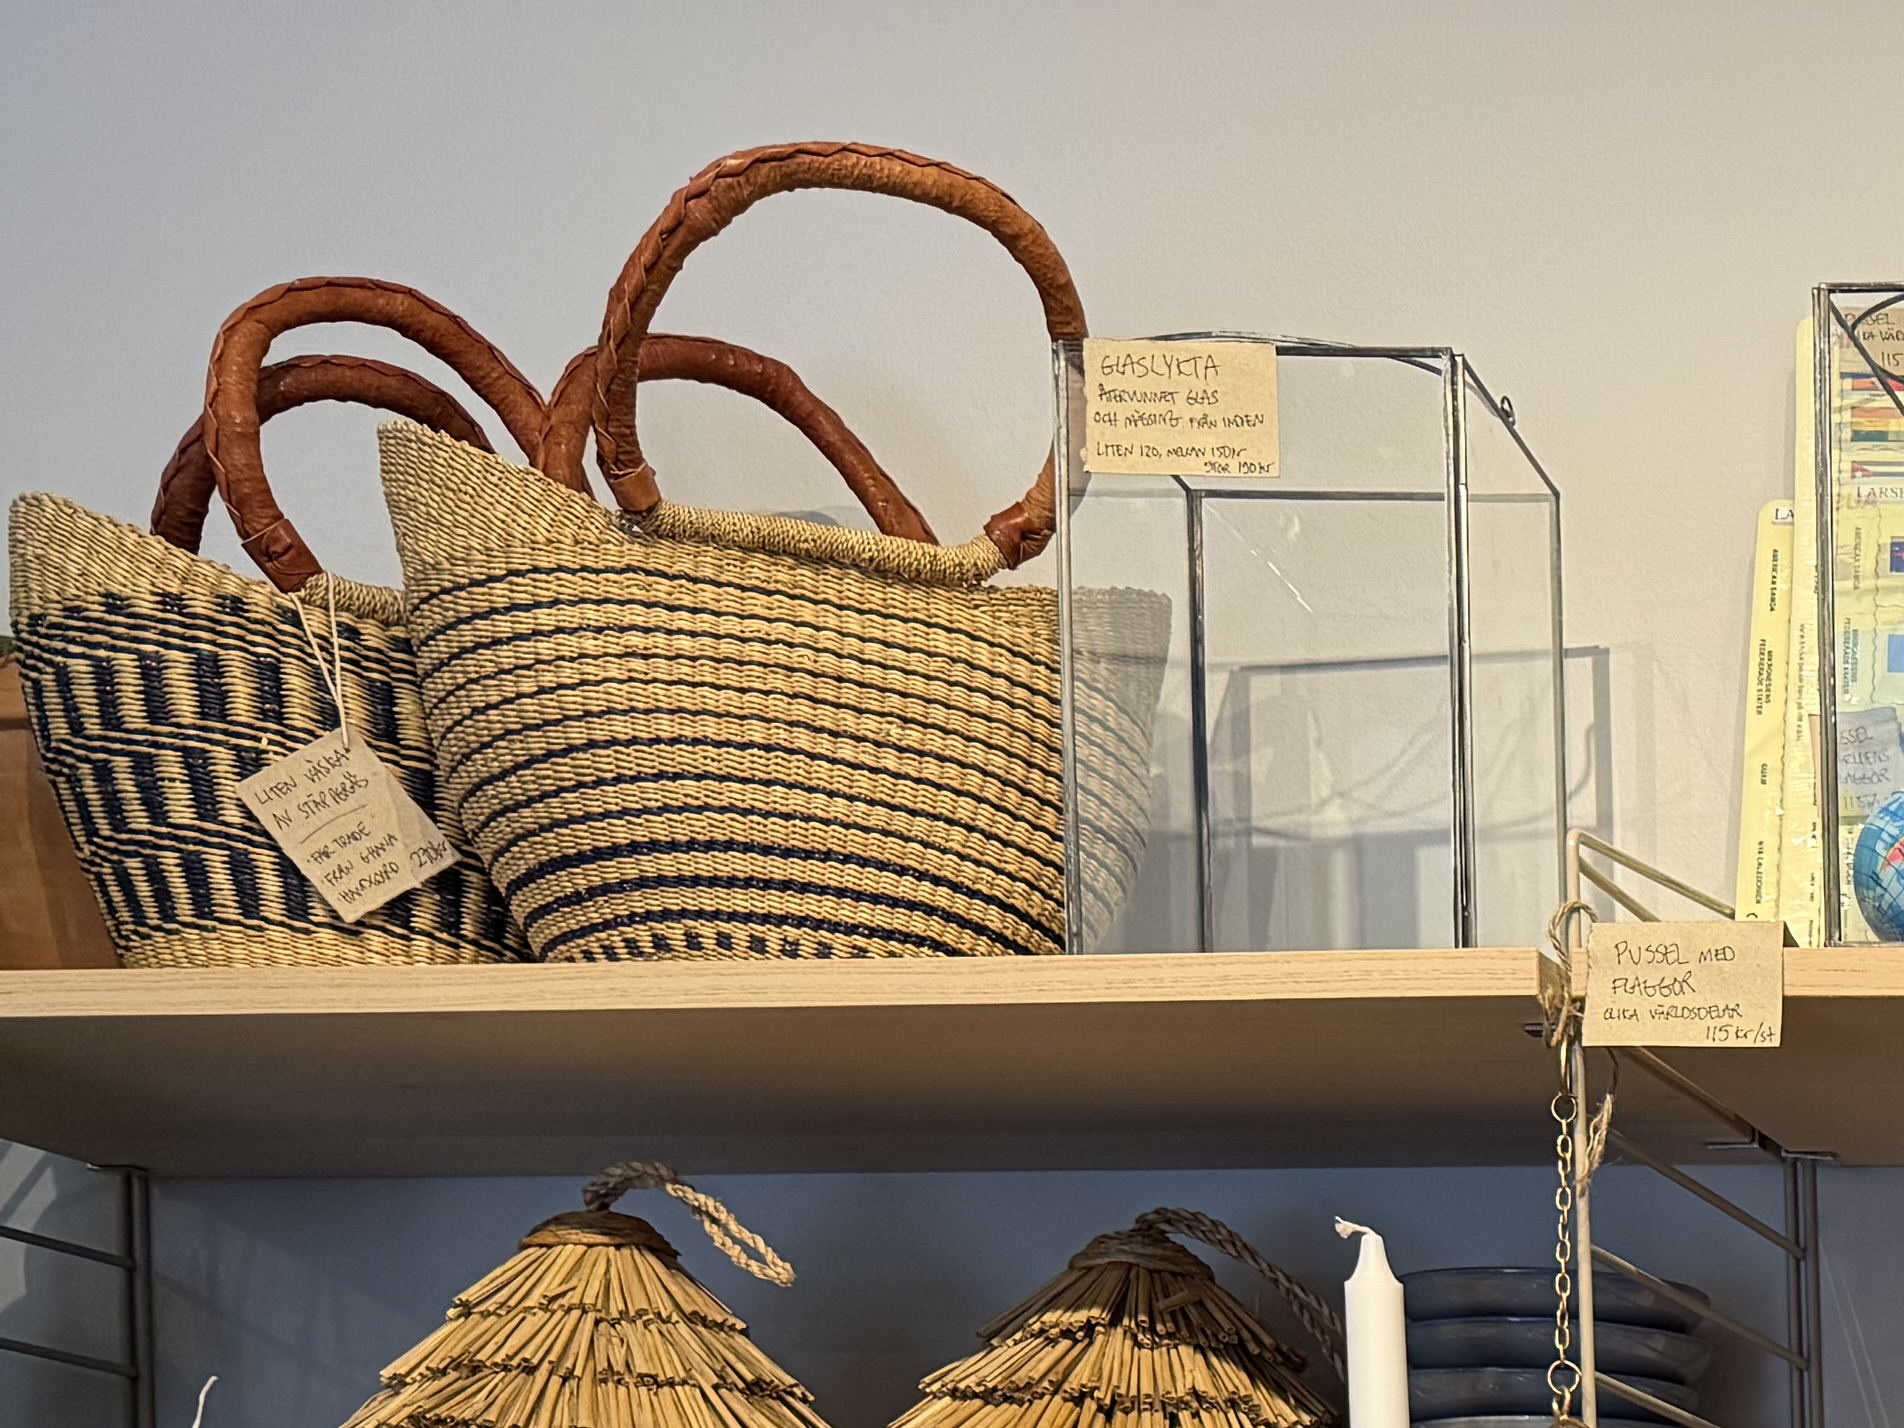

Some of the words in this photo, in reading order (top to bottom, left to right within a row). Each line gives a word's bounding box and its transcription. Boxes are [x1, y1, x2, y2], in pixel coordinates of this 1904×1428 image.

[1100, 353, 1221, 384] GLASLYKTA
[1614, 941, 1689, 965] PUSSEL
[1699, 946, 1735, 964] MED
[1612, 971, 1696, 997] FLAGGOR
